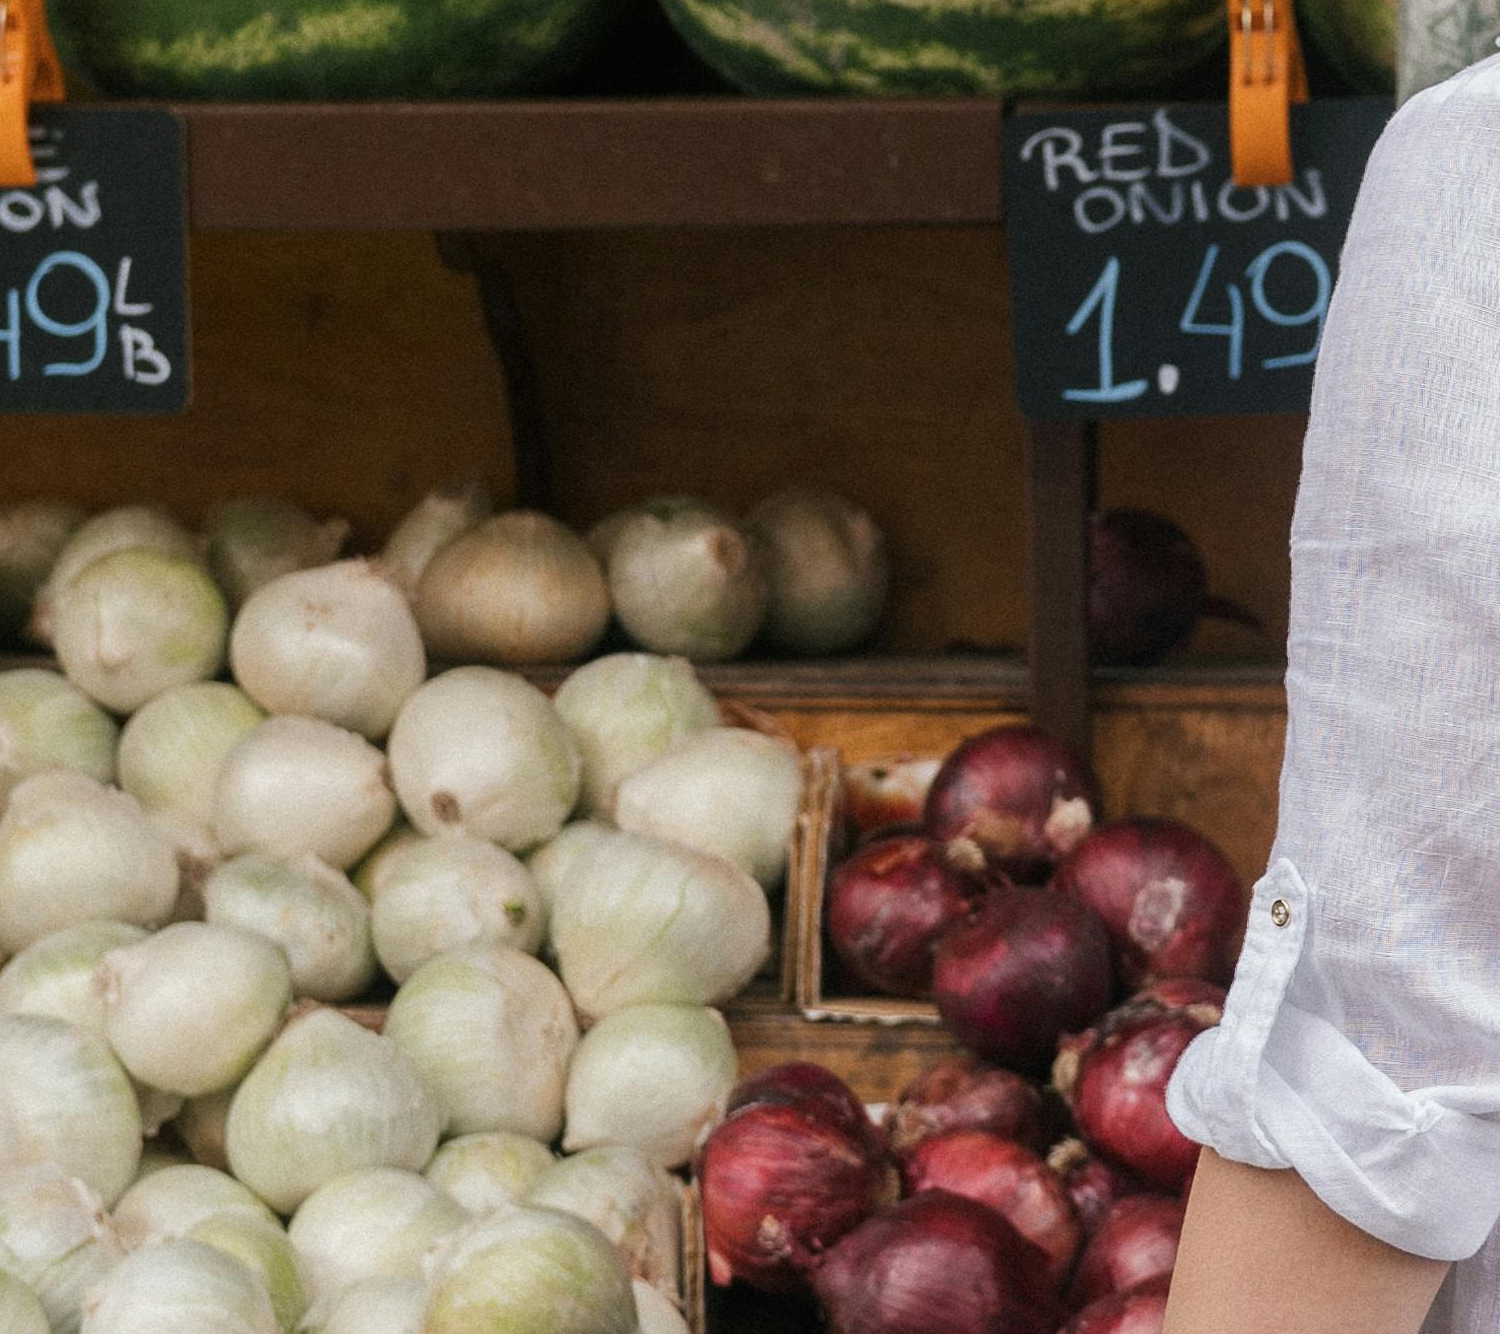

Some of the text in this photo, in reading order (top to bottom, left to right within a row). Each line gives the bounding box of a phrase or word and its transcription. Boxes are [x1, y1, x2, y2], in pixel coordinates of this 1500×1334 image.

[1021, 109, 1211, 191] RED
[1073, 169, 1327, 233] ONION
[1062, 240, 1332, 402] 1.49
